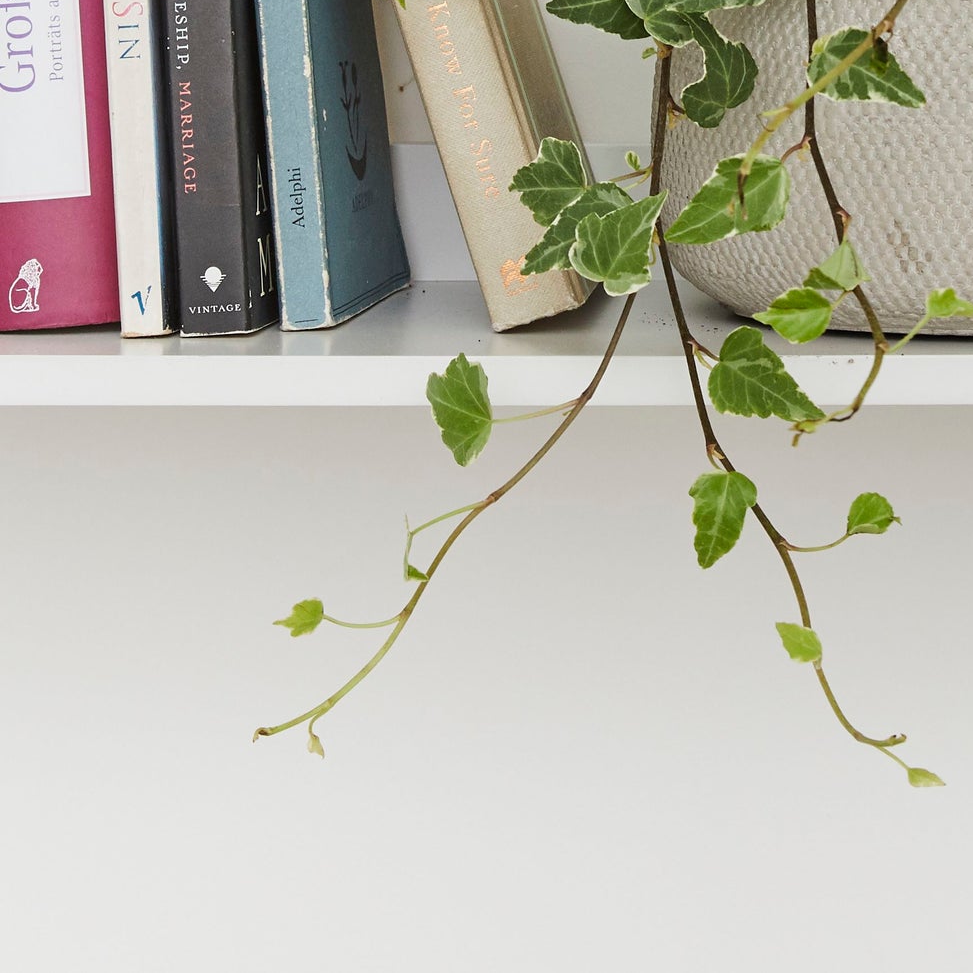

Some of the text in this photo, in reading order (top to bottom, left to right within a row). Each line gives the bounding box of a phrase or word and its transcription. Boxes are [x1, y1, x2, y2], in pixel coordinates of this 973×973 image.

[47, 15, 64, 81] Porträts
[111, 1, 145, 60] SIN
[429, 0, 462, 76] Know
[453, 84, 478, 129] For
[470, 137, 500, 199] Sure
[177, 81, 197, 195] MARRIAGE
[288, 166, 306, 229] Adelphi
[188, 302, 242, 316] VINTAGE
